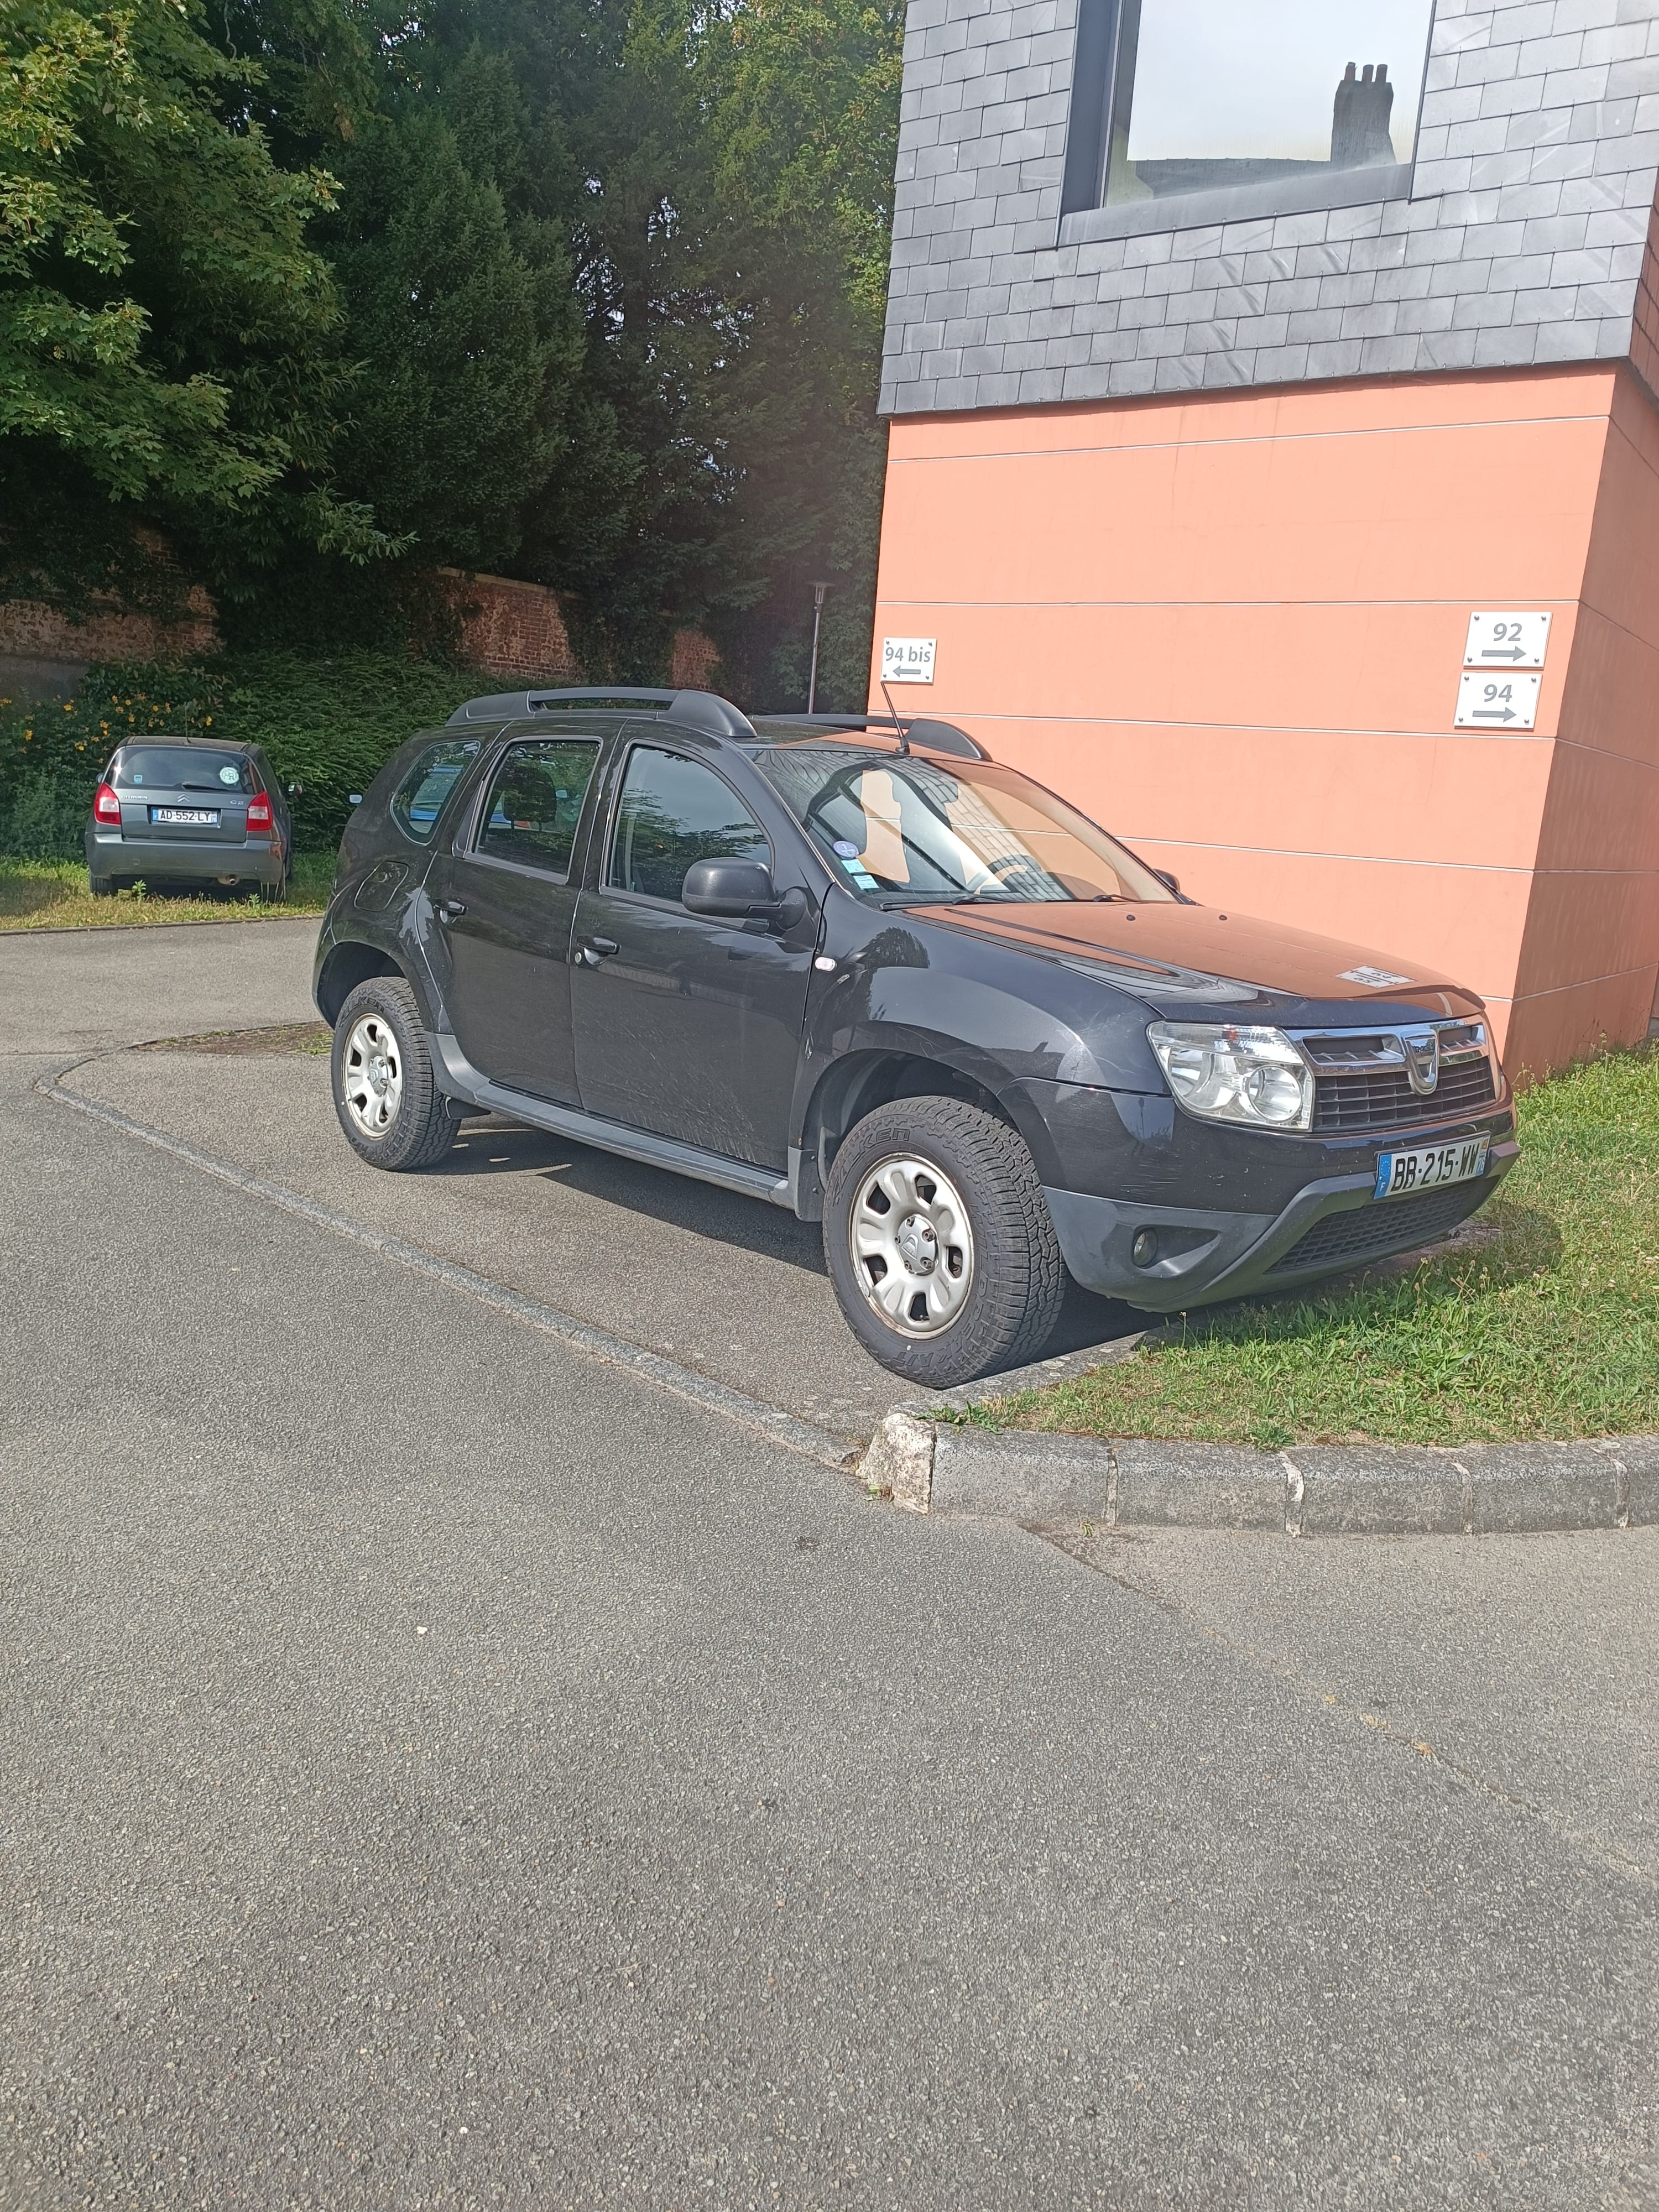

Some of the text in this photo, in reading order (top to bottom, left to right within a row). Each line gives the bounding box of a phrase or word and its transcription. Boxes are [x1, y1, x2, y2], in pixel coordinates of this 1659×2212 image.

[1493, 623, 1522, 641] 92
[885, 646, 931, 662] 94 bis
[1484, 684, 1512, 702] 94
